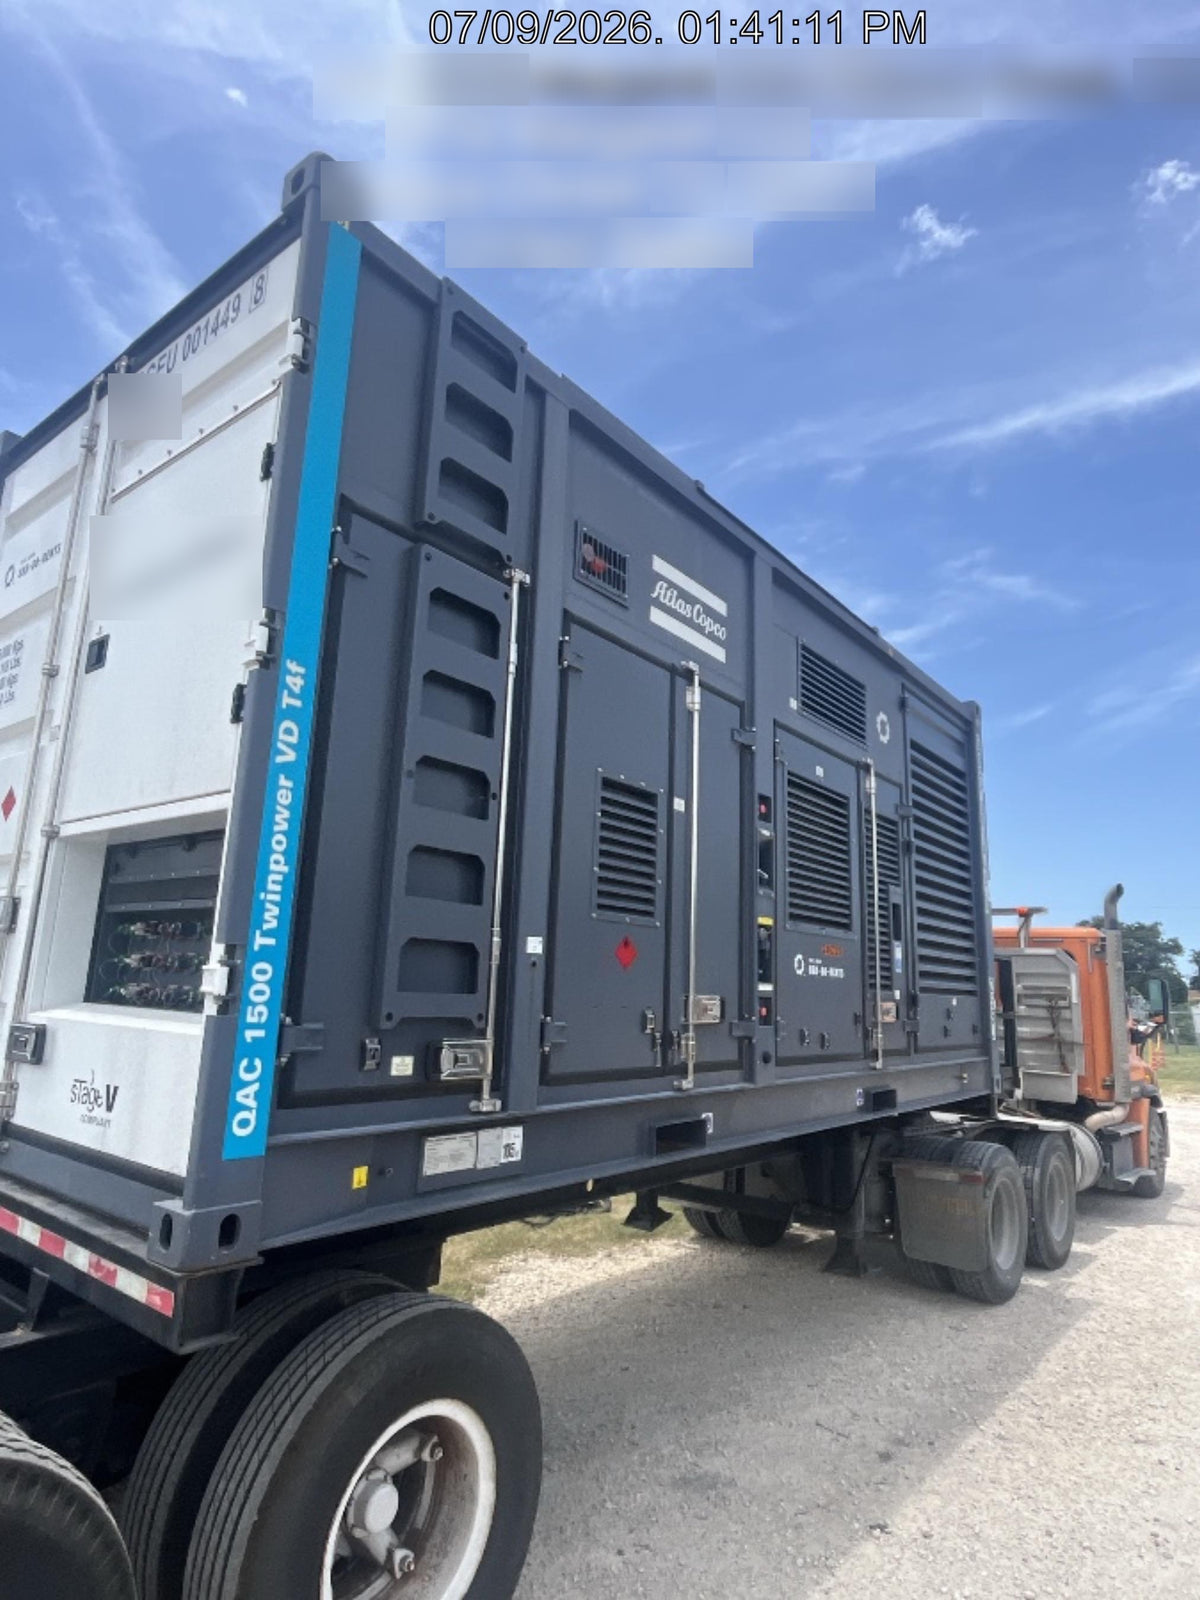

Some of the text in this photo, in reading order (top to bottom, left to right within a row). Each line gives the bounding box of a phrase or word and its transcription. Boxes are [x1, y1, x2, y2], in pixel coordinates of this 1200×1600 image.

[182, 292, 242, 362] 001449
[253, 273, 266, 306] 8
[649, 580, 727, 641] Atlas Copco
[231, 658, 307, 1138] QAC 1500 Twinpower VD T4f
[105, 1083, 120, 1113] V
